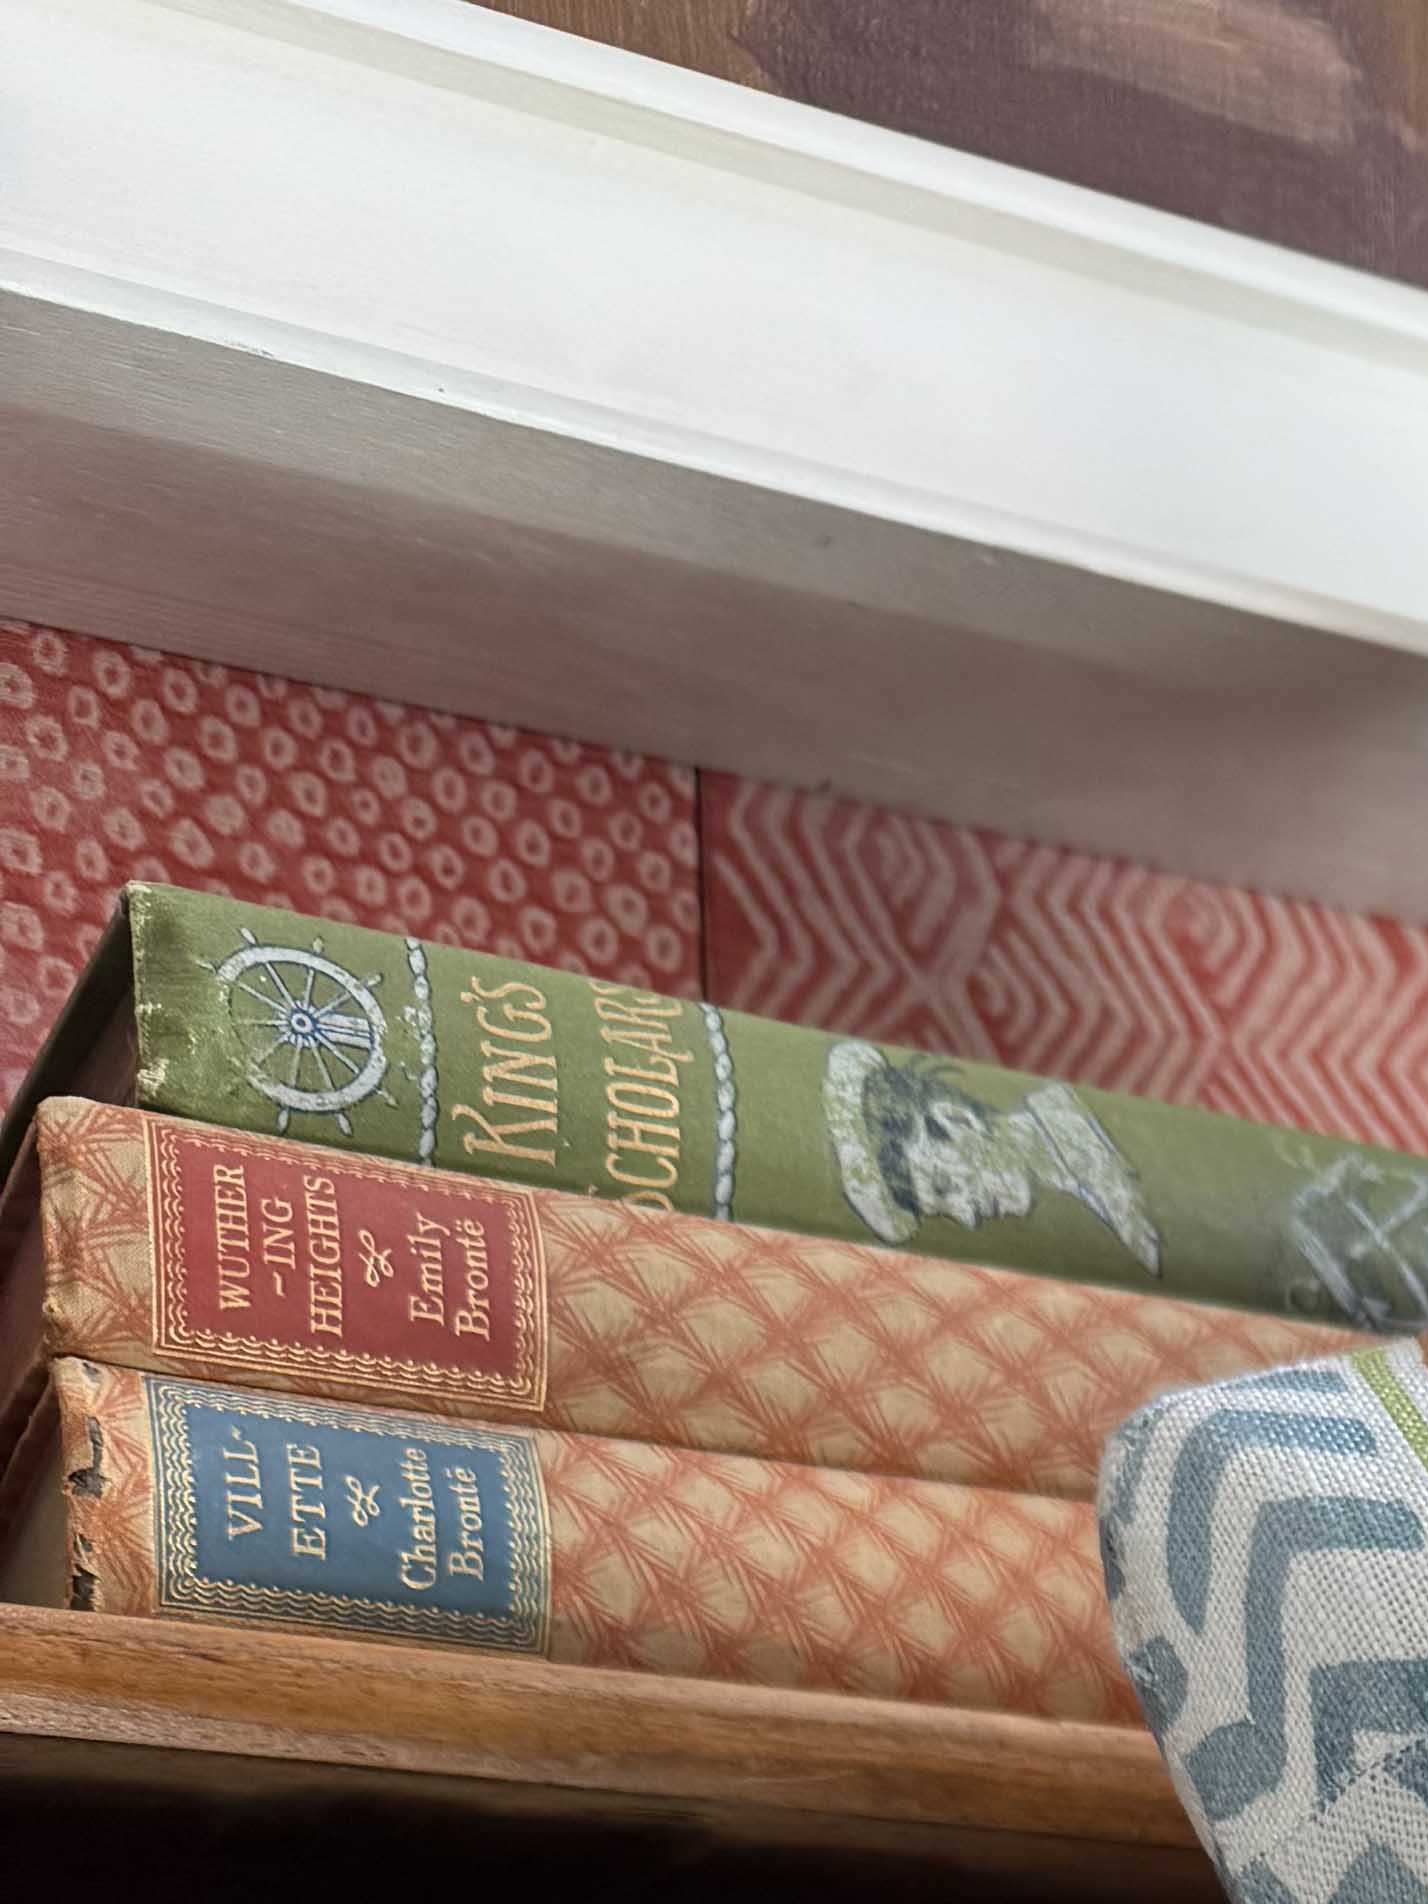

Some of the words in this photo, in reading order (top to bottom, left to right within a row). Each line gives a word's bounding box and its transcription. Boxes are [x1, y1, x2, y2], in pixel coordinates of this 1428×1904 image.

[451, 976, 557, 1166] KING'S
[213, 1165, 251, 1309] WUTHER
[303, 1175, 344, 1336] HEIGHTS
[408, 1210, 451, 1325] Emily
[452, 1216, 492, 1339] Brontë
[286, 1442, 328, 1560] ETTE
[397, 1447, 441, 1591] Charlotte
